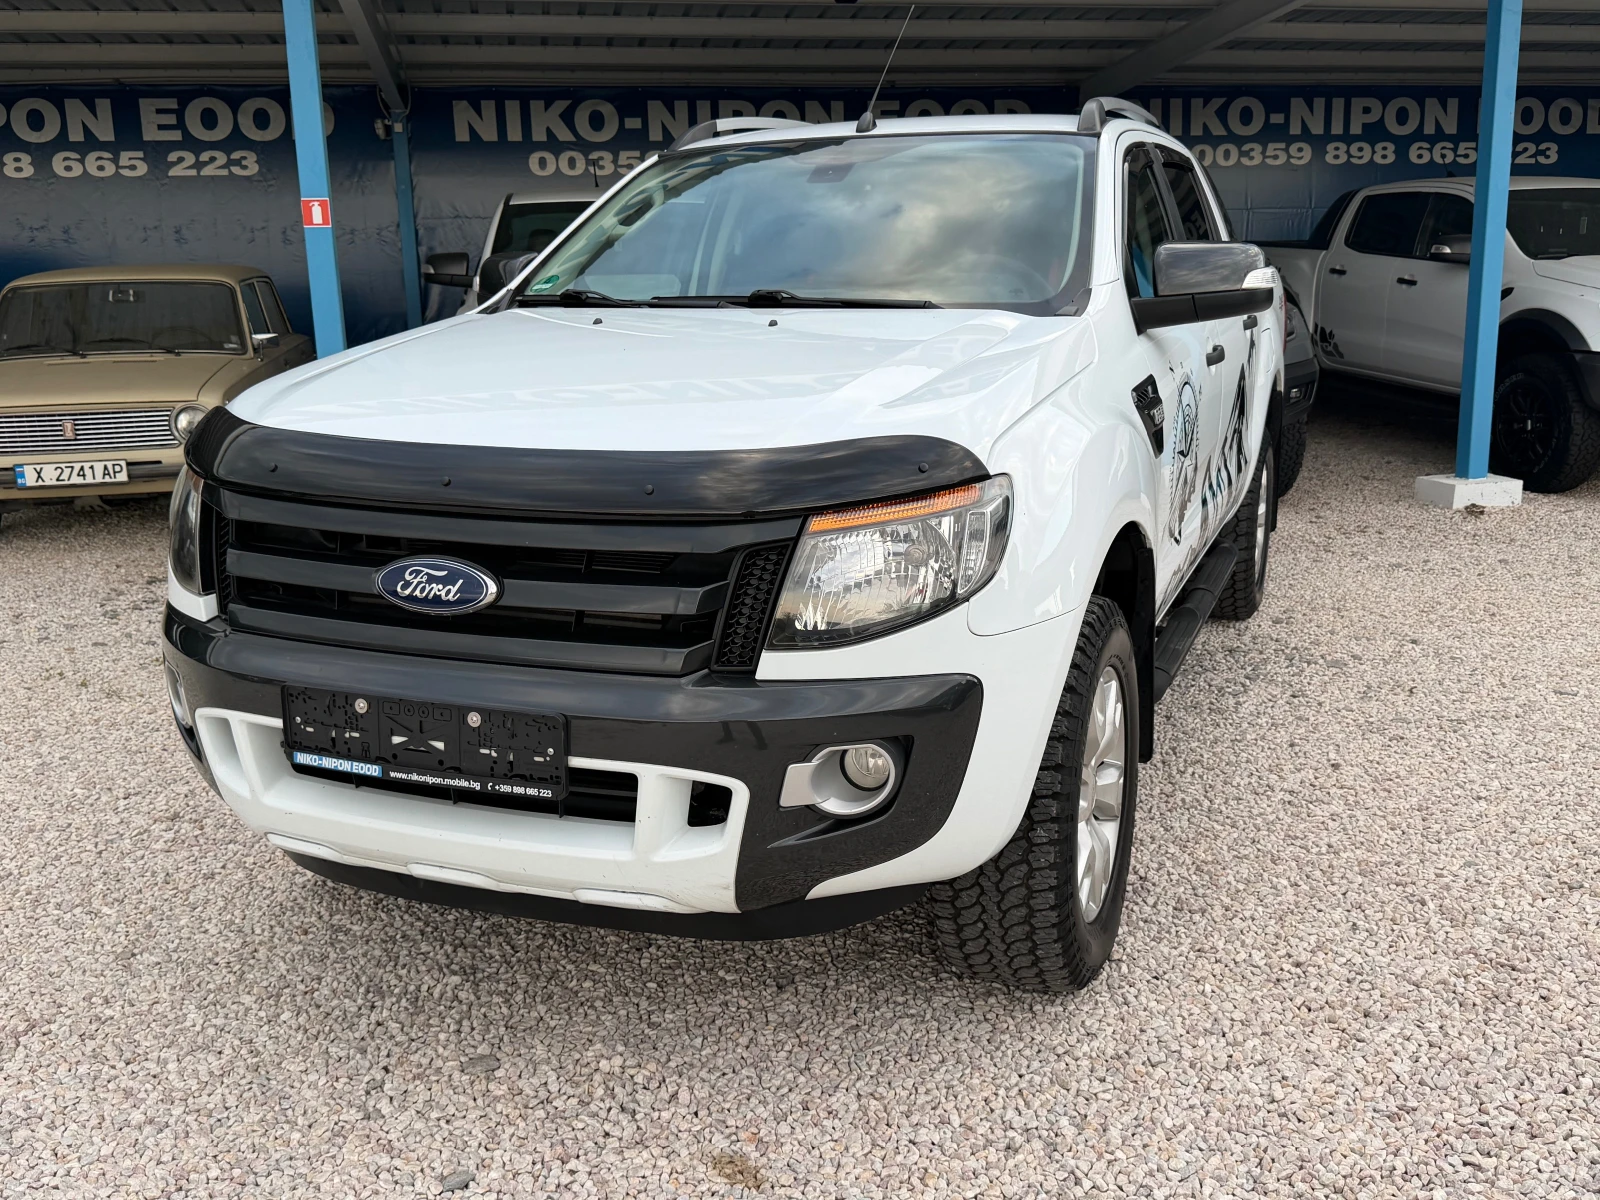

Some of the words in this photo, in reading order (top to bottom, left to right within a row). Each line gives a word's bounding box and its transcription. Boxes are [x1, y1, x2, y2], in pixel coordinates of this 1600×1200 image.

[0, 97, 115, 143] ON
[1477, 96, 1600, 136] OO
[52, 151, 148, 178] 665
[167, 150, 260, 176] 223
[528, 150, 658, 177] 0035
[1192, 142, 1312, 167] 00359
[1325, 141, 1396, 166] 898
[1408, 140, 1478, 165] 665
[1513, 141, 1559, 165] 23
[54, 465, 97, 482] 2741
[102, 463, 124, 480] AP
[396, 566, 464, 602] Ford
[297, 752, 352, 772] NIKO-NIPON
[352, 761, 379, 776] EOOD
[389, 770, 481, 790] www.nikonipon.mobile.bg
[494, 784, 512, 793] +359
[512, 786, 525, 795] 898
[526, 787, 539, 796] 665
[539, 788, 552, 797] 223
